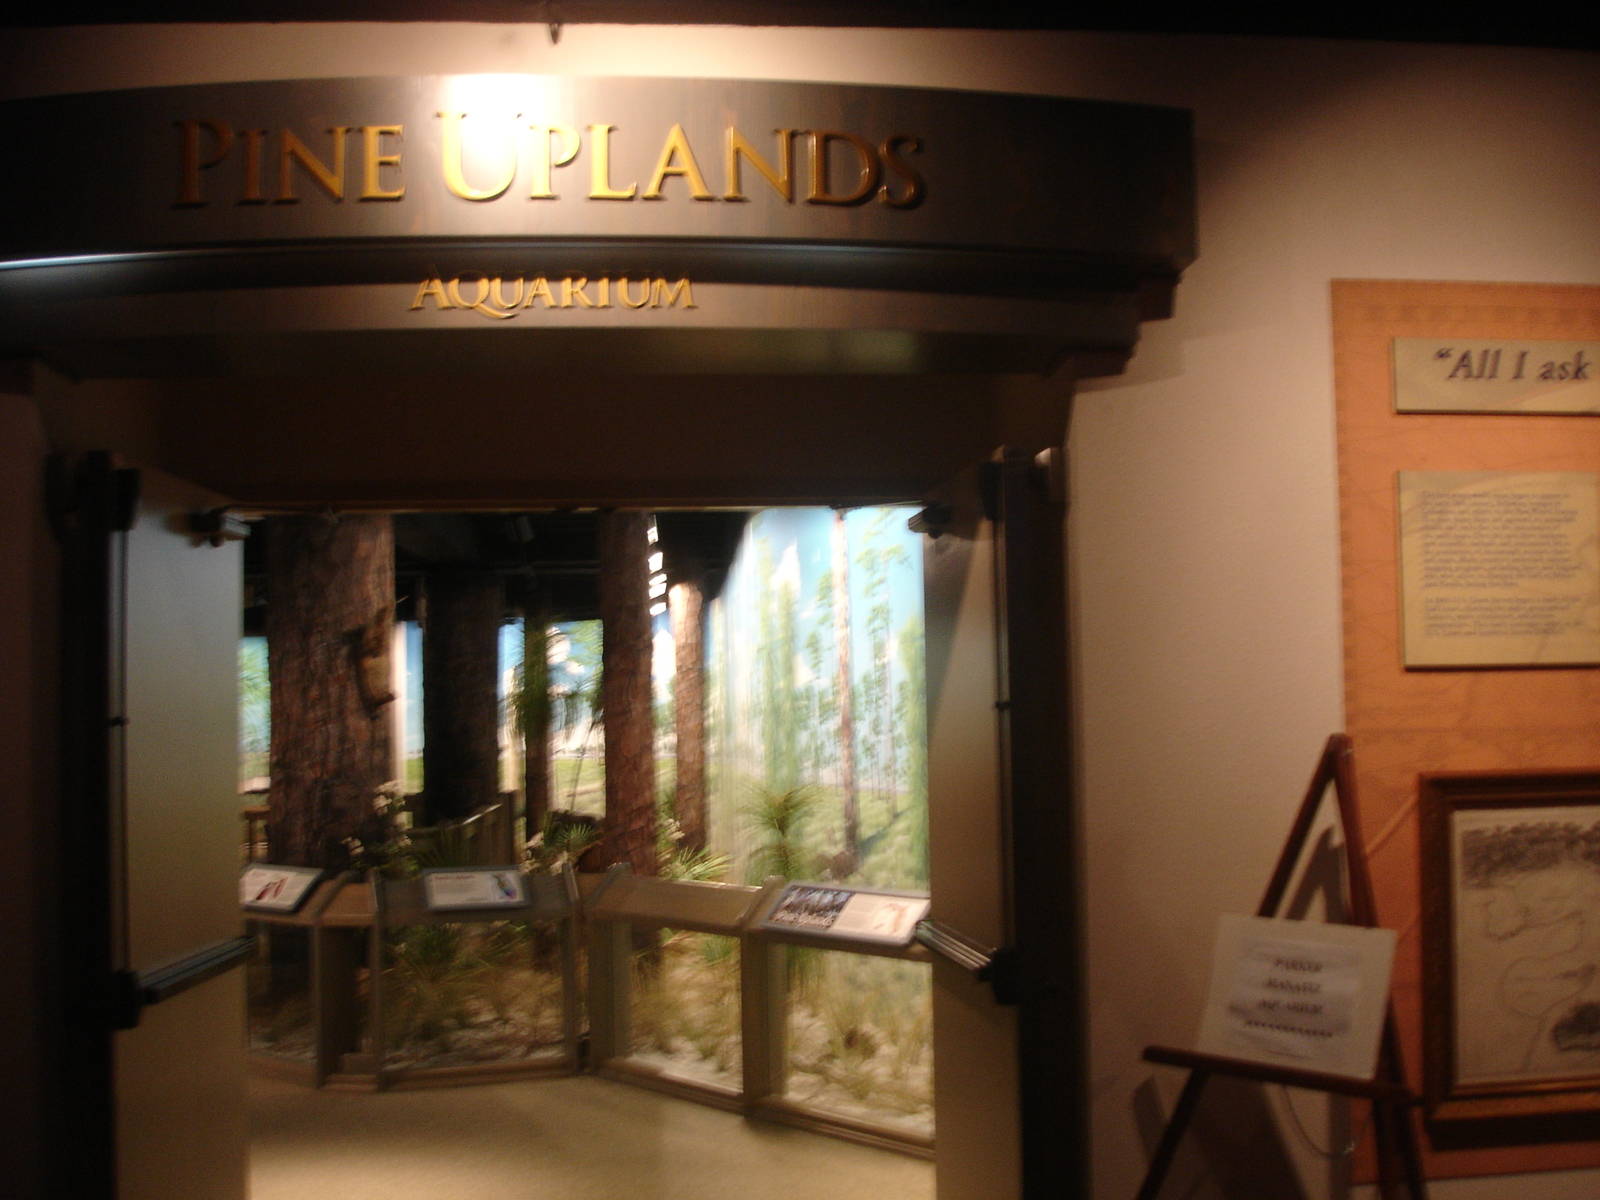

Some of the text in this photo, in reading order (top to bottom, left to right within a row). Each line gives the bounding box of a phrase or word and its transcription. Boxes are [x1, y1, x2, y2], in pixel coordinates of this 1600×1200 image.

[173, 110, 928, 209] PINE UPLANDS
[410, 268, 698, 320] AQUARIUM
[1511, 349, 1529, 381] I
[1537, 349, 1592, 382] ask
